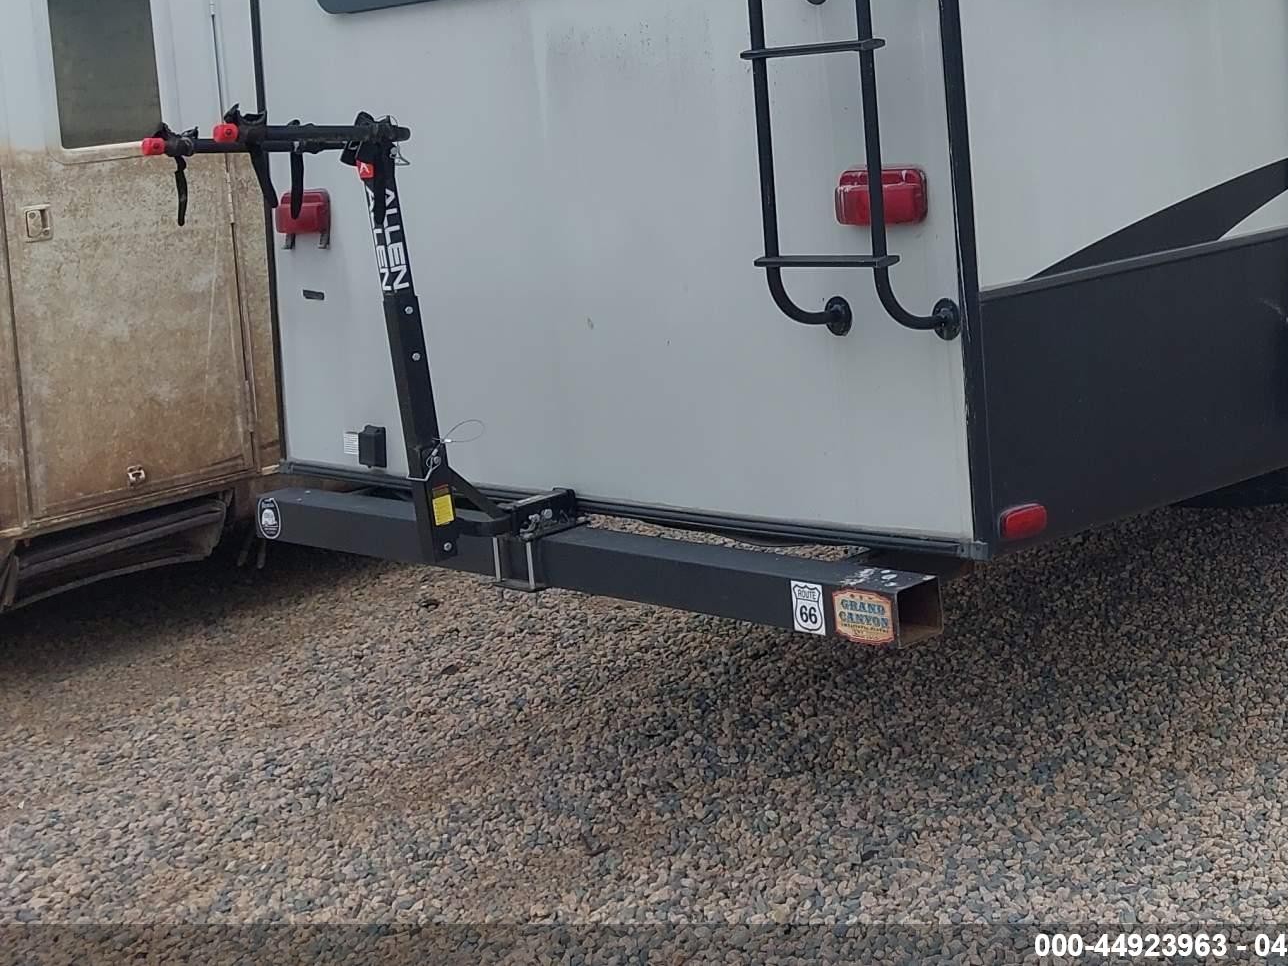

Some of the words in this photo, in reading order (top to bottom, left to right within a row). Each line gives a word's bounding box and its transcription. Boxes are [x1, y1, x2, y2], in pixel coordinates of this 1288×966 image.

[384, 188, 410, 291] ALLEN
[797, 588, 818, 601] ROUTE
[799, 605, 818, 625] 66
[841, 598, 885, 615] GRAND
[838, 610, 889, 628] CANYON
